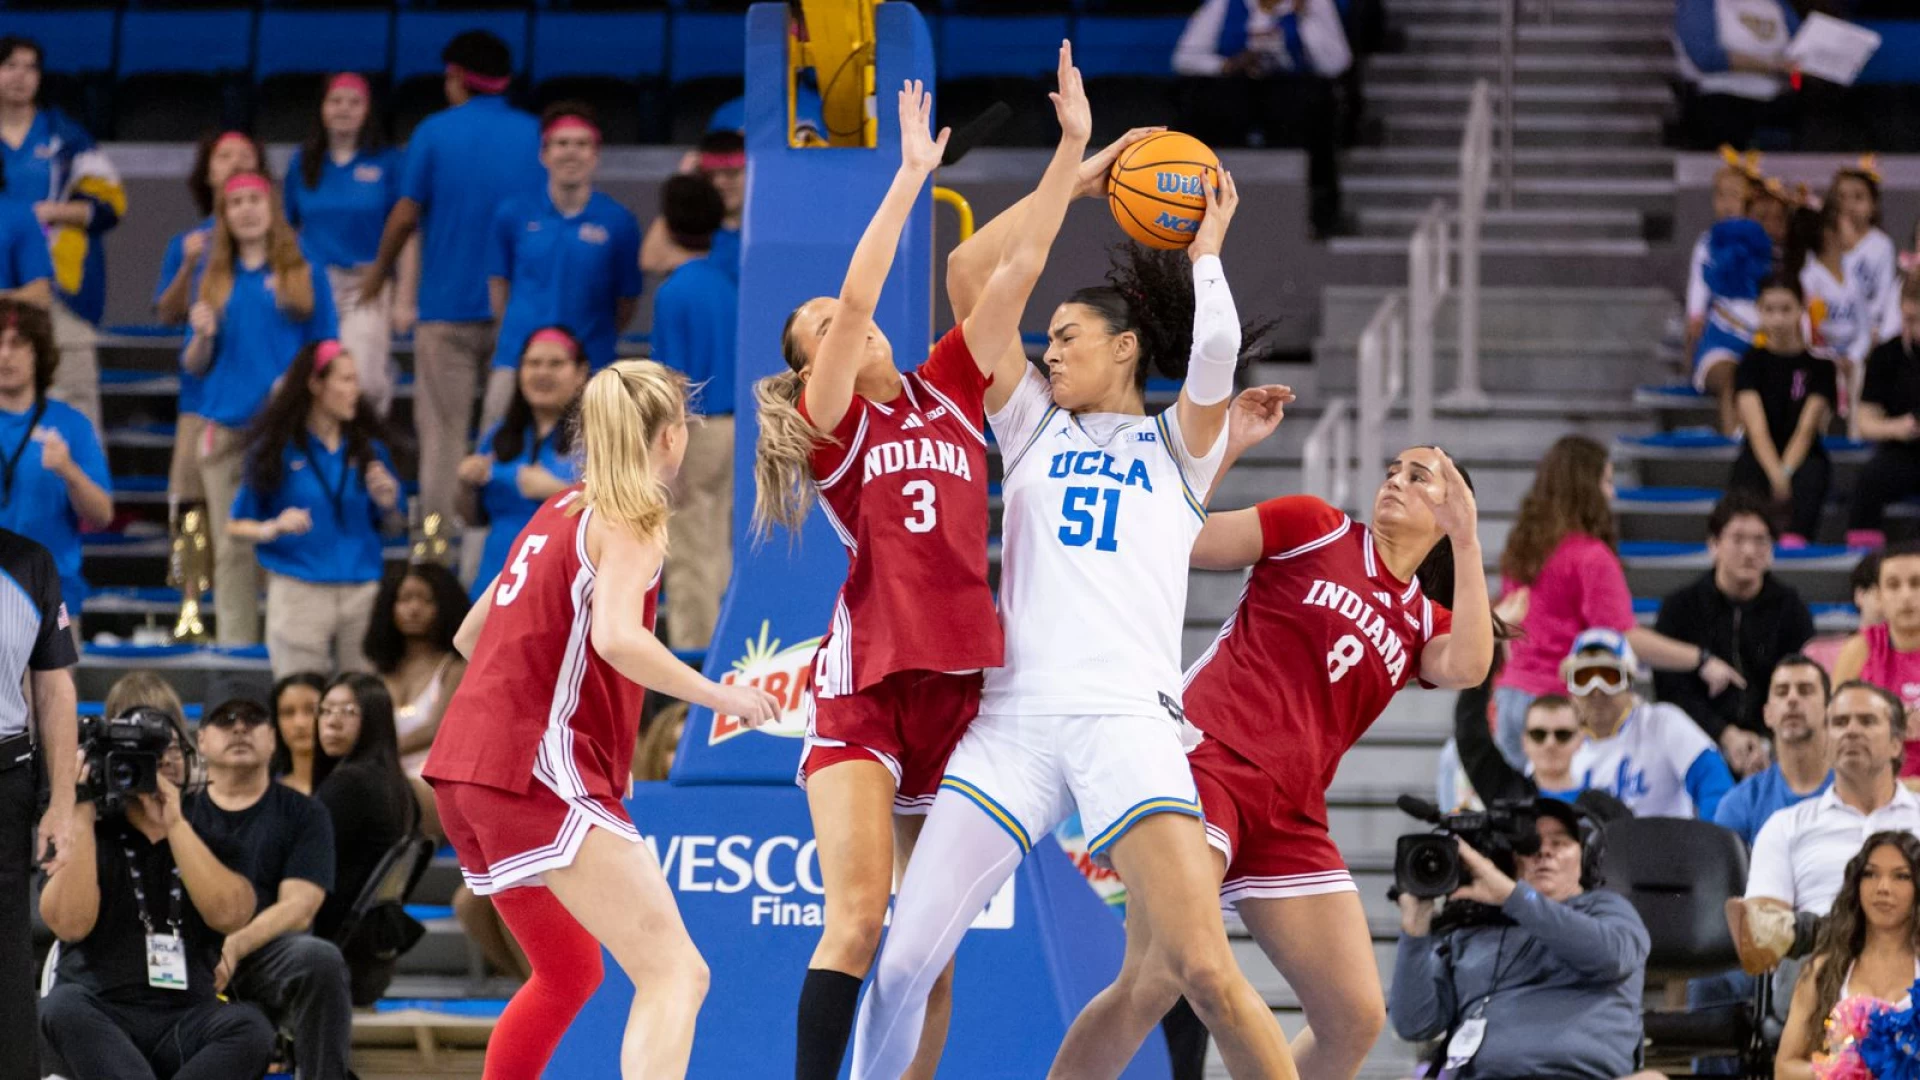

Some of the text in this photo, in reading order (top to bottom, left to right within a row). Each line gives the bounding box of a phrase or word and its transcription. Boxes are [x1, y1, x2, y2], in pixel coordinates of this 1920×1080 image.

[1154, 211, 1200, 233] NCA
[862, 437, 972, 485] NDIANA
[1048, 450, 1153, 493] UCLA
[902, 479, 937, 533] 3
[1058, 486, 1121, 552] 51
[496, 534, 549, 606] 5
[1302, 579, 1407, 687] INDIANA
[1326, 634, 1364, 683] 8
[751, 896, 825, 926] Fina
